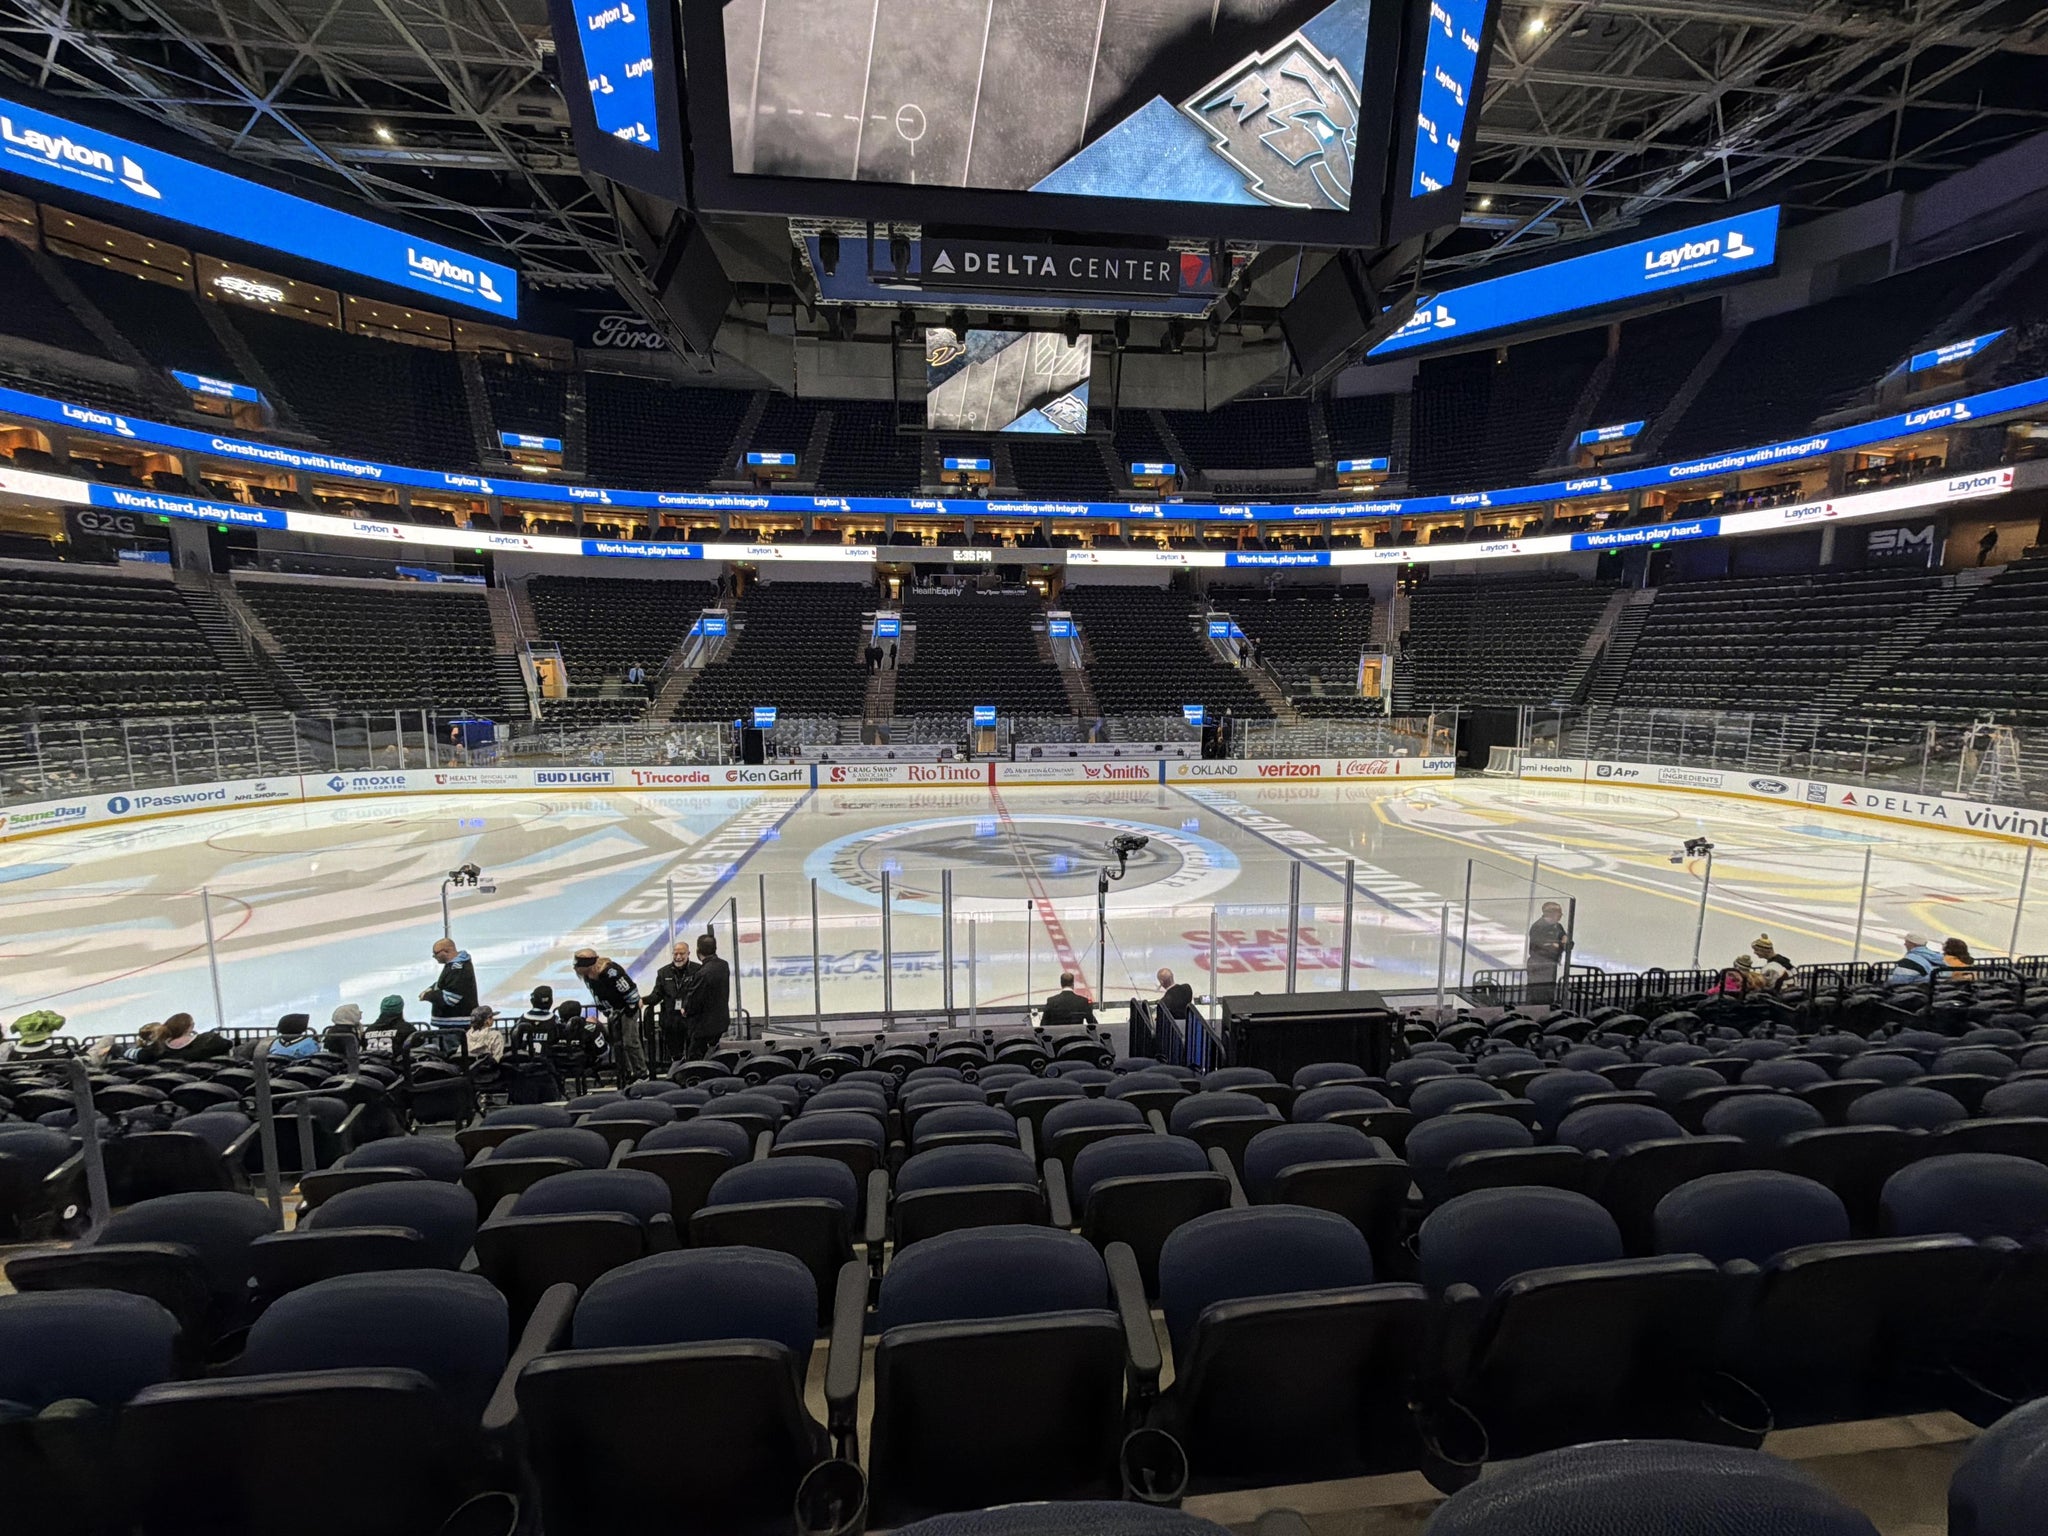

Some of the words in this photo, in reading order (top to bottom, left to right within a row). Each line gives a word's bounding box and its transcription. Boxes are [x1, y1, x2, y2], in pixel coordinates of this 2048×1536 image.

[589, 7, 620, 30] Layton
[1462, 28, 1479, 53] Layto
[625, 58, 653, 78] Layto
[1436, 65, 1457, 93] Layton
[1, 116, 114, 173] Layton
[1447, 133, 1460, 153] Lay
[1646, 239, 1720, 270] Layton
[408, 247, 474, 285] Layton
[964, 251, 1057, 277] DELTA
[1069, 257, 1171, 282] CENTER
[63, 404, 112, 426] Layton
[1905, 405, 1951, 426] Layton
[212, 438, 301, 466] Constructing
[301, 456, 329, 469] with
[330, 459, 382, 479] Integrity
[1669, 455, 1745, 477] Constructing
[1745, 450, 1773, 464] with
[1774, 438, 1829, 459] Integrity
[445, 474, 479, 488] Layton
[1566, 479, 1598, 492] Layton
[1948, 475, 1997, 492] Layton
[569, 488, 598, 498] Layton
[1451, 494, 1479, 505] Layton
[113, 491, 158, 510] Work
[159, 497, 198, 517] hard,
[199, 505, 230, 521] play
[231, 508, 267, 524] hard.
[658, 496, 715, 507] Constructing
[715, 497, 733, 506] with
[734, 497, 769, 508] Integrity
[814, 498, 839, 507] Layton
[911, 500, 935, 510] Layton
[987, 503, 1038, 513] Constructing
[1038, 504, 1055, 513] with
[1056, 505, 1088, 514] Integrity
[1130, 505, 1153, 514] Layton
[1220, 506, 1243, 516] Layton
[1294, 505, 1345, 517] Constructing
[1346, 504, 1365, 513] with
[1365, 503, 1402, 513] Integrity
[1784, 505, 1822, 519] Layton
[77, 511, 136, 532] G2G
[353, 521, 389, 535] Layton
[488, 535, 520, 546] Layton
[1588, 535, 1617, 546] Work
[1617, 531, 1646, 543] hard,
[1646, 529, 1671, 541] play
[1672, 524, 1702, 537] hard.
[1868, 524, 1935, 550] SM
[597, 543, 622, 553] Work
[623, 544, 647, 556] hard,
[648, 546, 667, 556] play
[667, 546, 690, 556] hard.
[747, 547, 772, 555] Layton
[845, 548, 869, 557] Layton
[1480, 543, 1509, 552] Layton
[976, 550, 992, 562] PM
[1156, 553, 1179, 561] Layton
[1237, 555, 1260, 563] Work
[1259, 555, 1279, 565] hard,
[1279, 556, 1296, 565] play
[1297, 555, 1318, 564] hard.
[1375, 551, 1400, 559] Layton
[912, 587, 964, 597] HealthEquity
[1103, 763, 1150, 779] Smith's
[1192, 764, 1238, 776] OKLAND
[1257, 761, 1320, 776] verizon
[1422, 759, 1455, 771] Layton
[1541, 764, 1572, 773] Health
[352, 775, 406, 786] moxie
[537, 772, 567, 784] BUD
[569, 772, 611, 783] LIGHT
[644, 770, 710, 783] Trucordia
[739, 770, 766, 782] Ken
[769, 769, 802, 782] Garff
[908, 765, 935, 782] Rio
[936, 765, 980, 780] Tinto
[1662, 773, 1719, 784] INGREDIENTS
[134, 788, 226, 808] 1Password
[1866, 794, 1947, 818] DELTA
[10, 806, 87, 824] SameDay
[1181, 926, 1323, 950] SEAT
